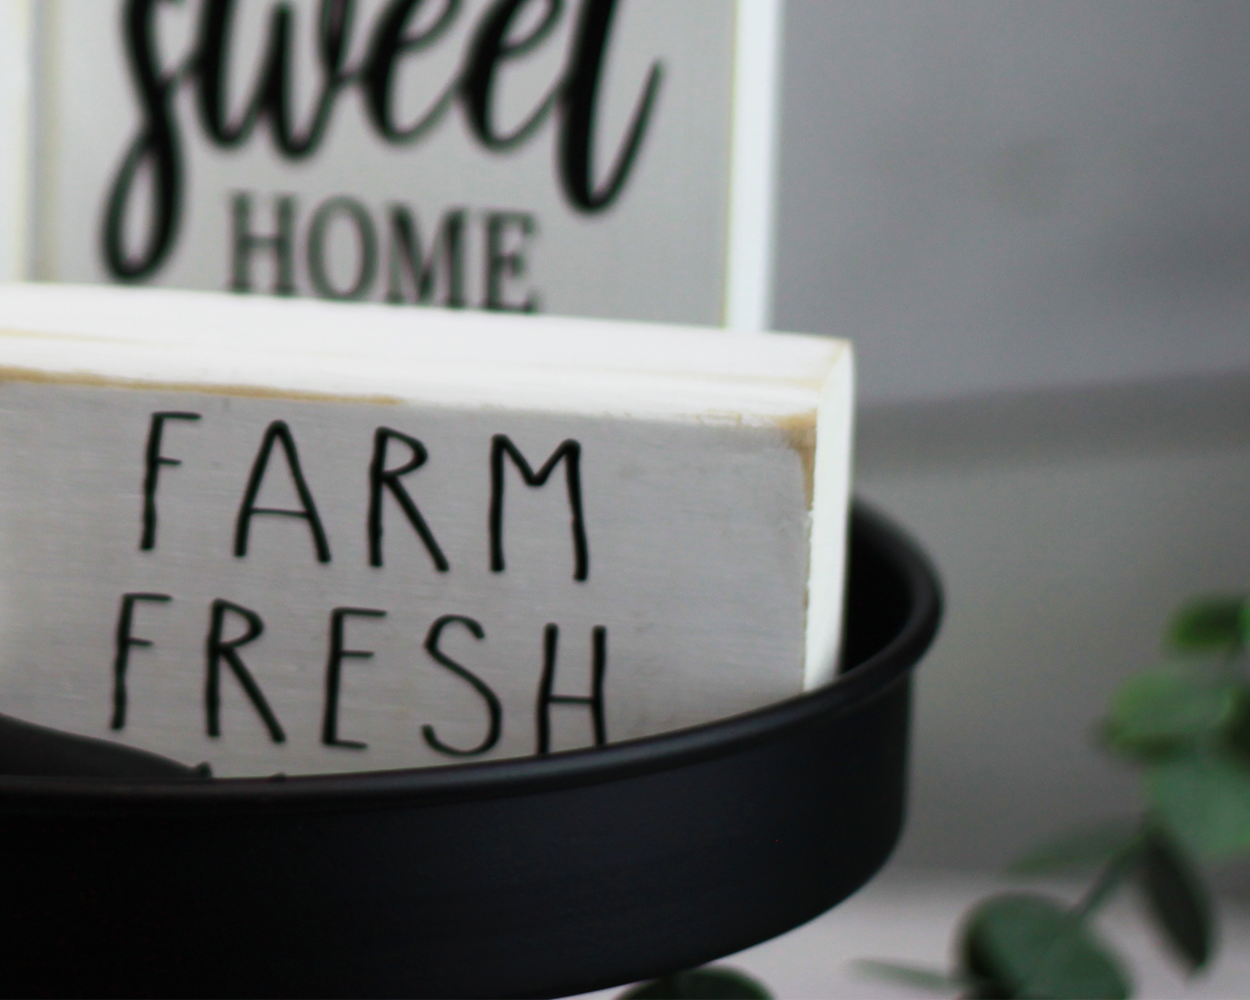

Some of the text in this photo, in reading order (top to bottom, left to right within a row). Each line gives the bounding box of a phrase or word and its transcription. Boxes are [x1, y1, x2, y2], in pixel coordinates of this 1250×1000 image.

[229, 193, 539, 315] HOME
[140, 411, 589, 582] FARM
[111, 594, 607, 755] FRESH
